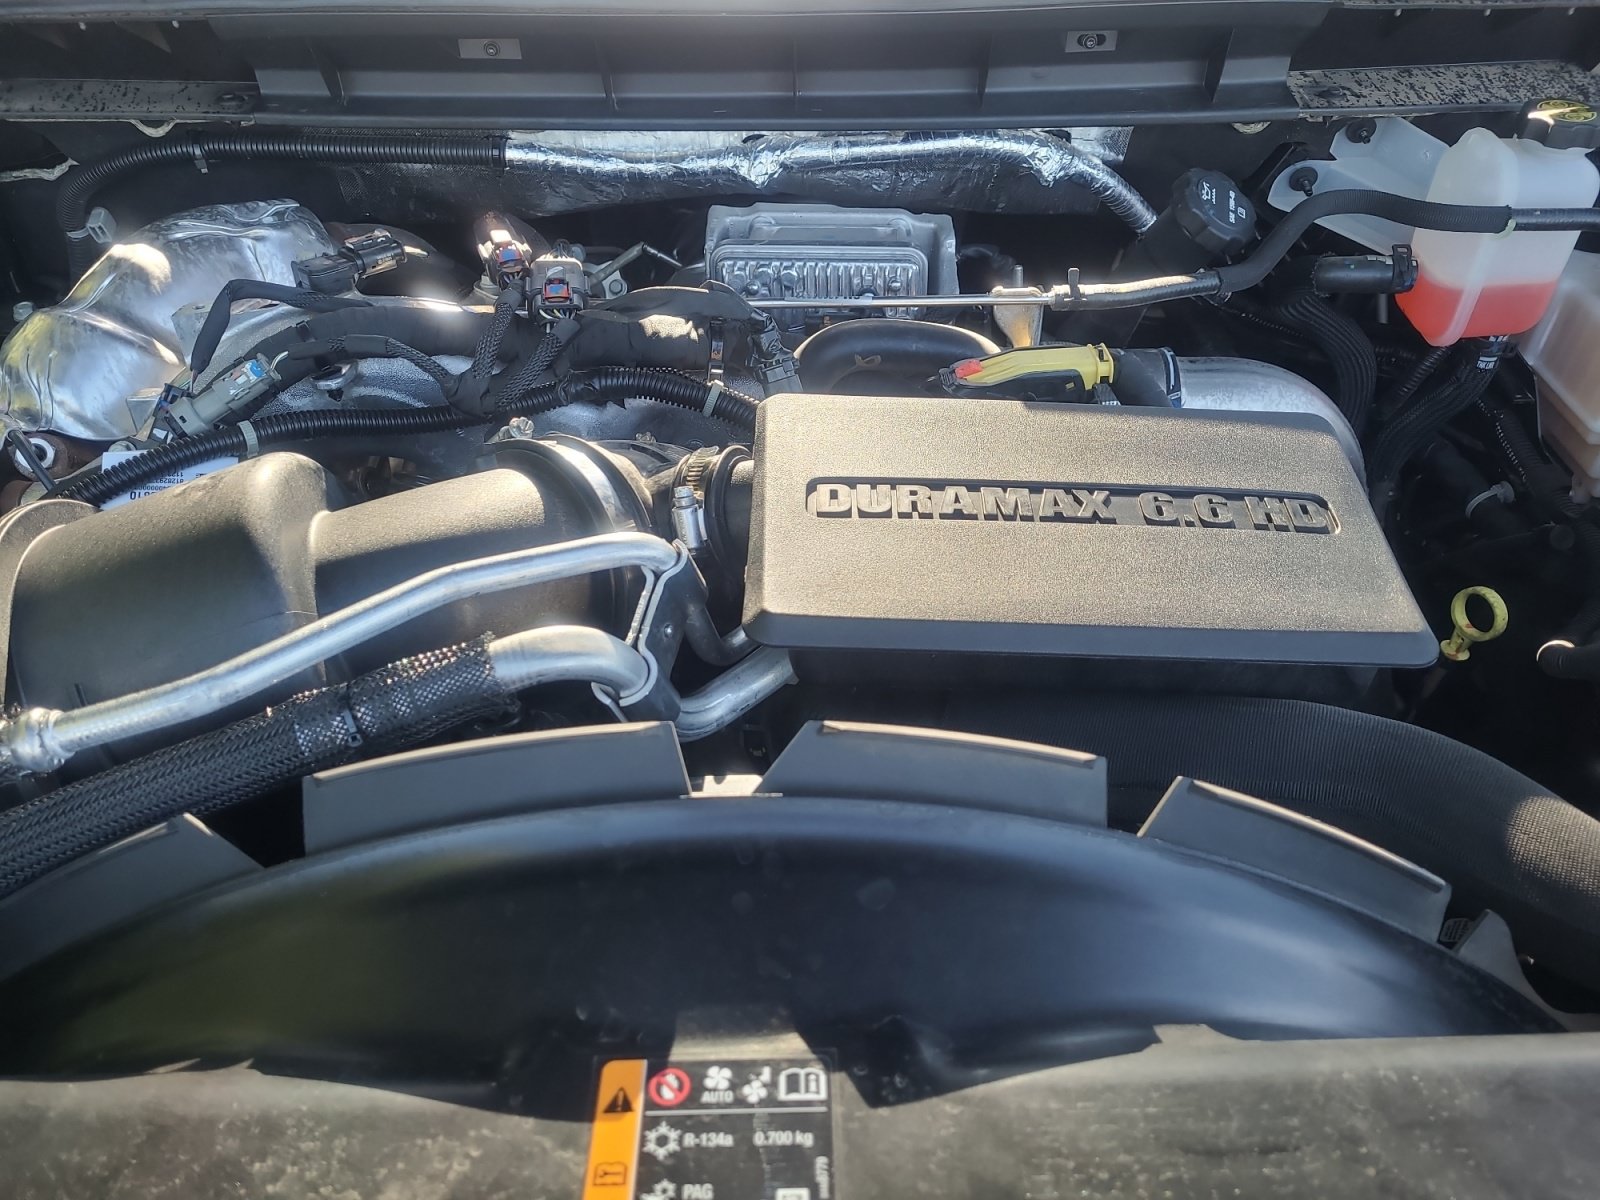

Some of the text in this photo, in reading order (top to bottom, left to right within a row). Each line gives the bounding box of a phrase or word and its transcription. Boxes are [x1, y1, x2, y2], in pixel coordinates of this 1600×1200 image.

[816, 484, 1329, 531] DURAMAX 6.6 HD
[701, 1090, 734, 1103] AUTO
[682, 1131, 814, 1148] R-134a 0.700 kg
[682, 1183, 714, 1200] PAG
